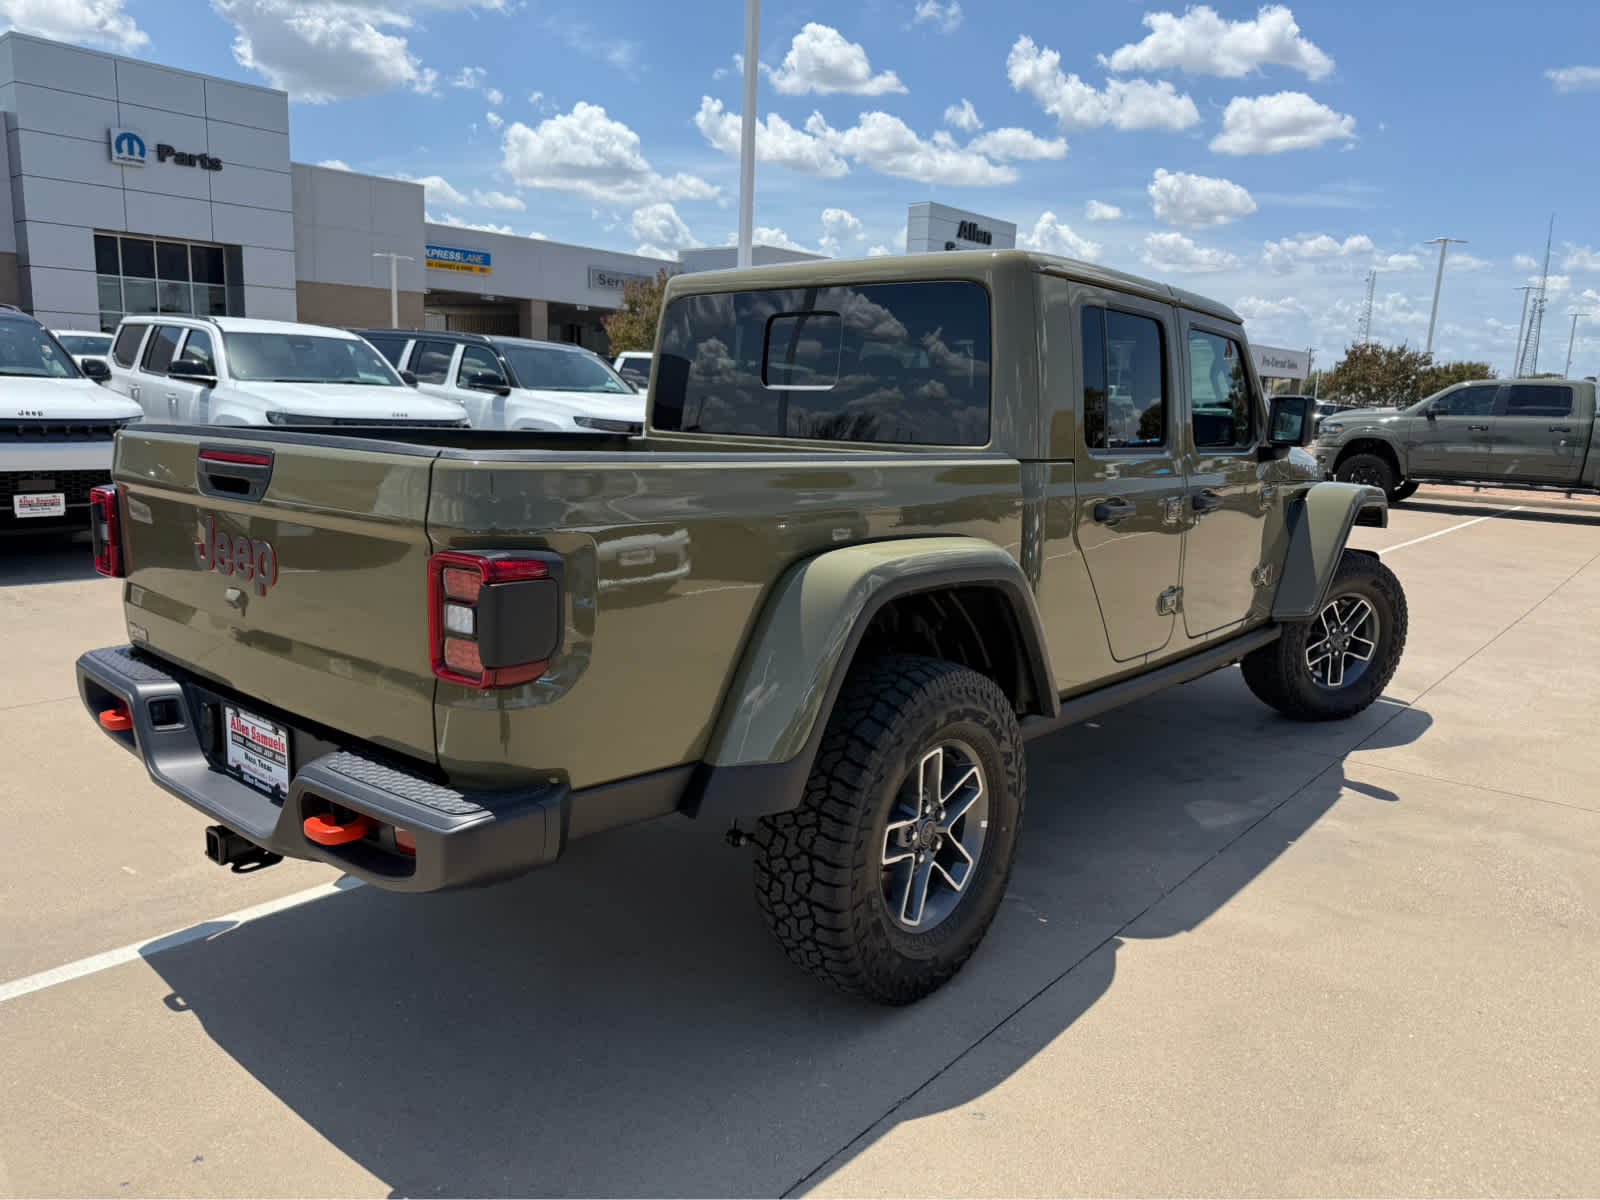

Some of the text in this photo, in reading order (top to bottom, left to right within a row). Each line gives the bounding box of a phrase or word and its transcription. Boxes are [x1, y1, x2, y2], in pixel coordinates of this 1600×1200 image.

[157, 143, 223, 171] Parts
[956, 220, 993, 246] Allen
[194, 516, 278, 597] Jeep
[231, 716, 250, 736] Allen
[251, 726, 286, 753] Samuels
